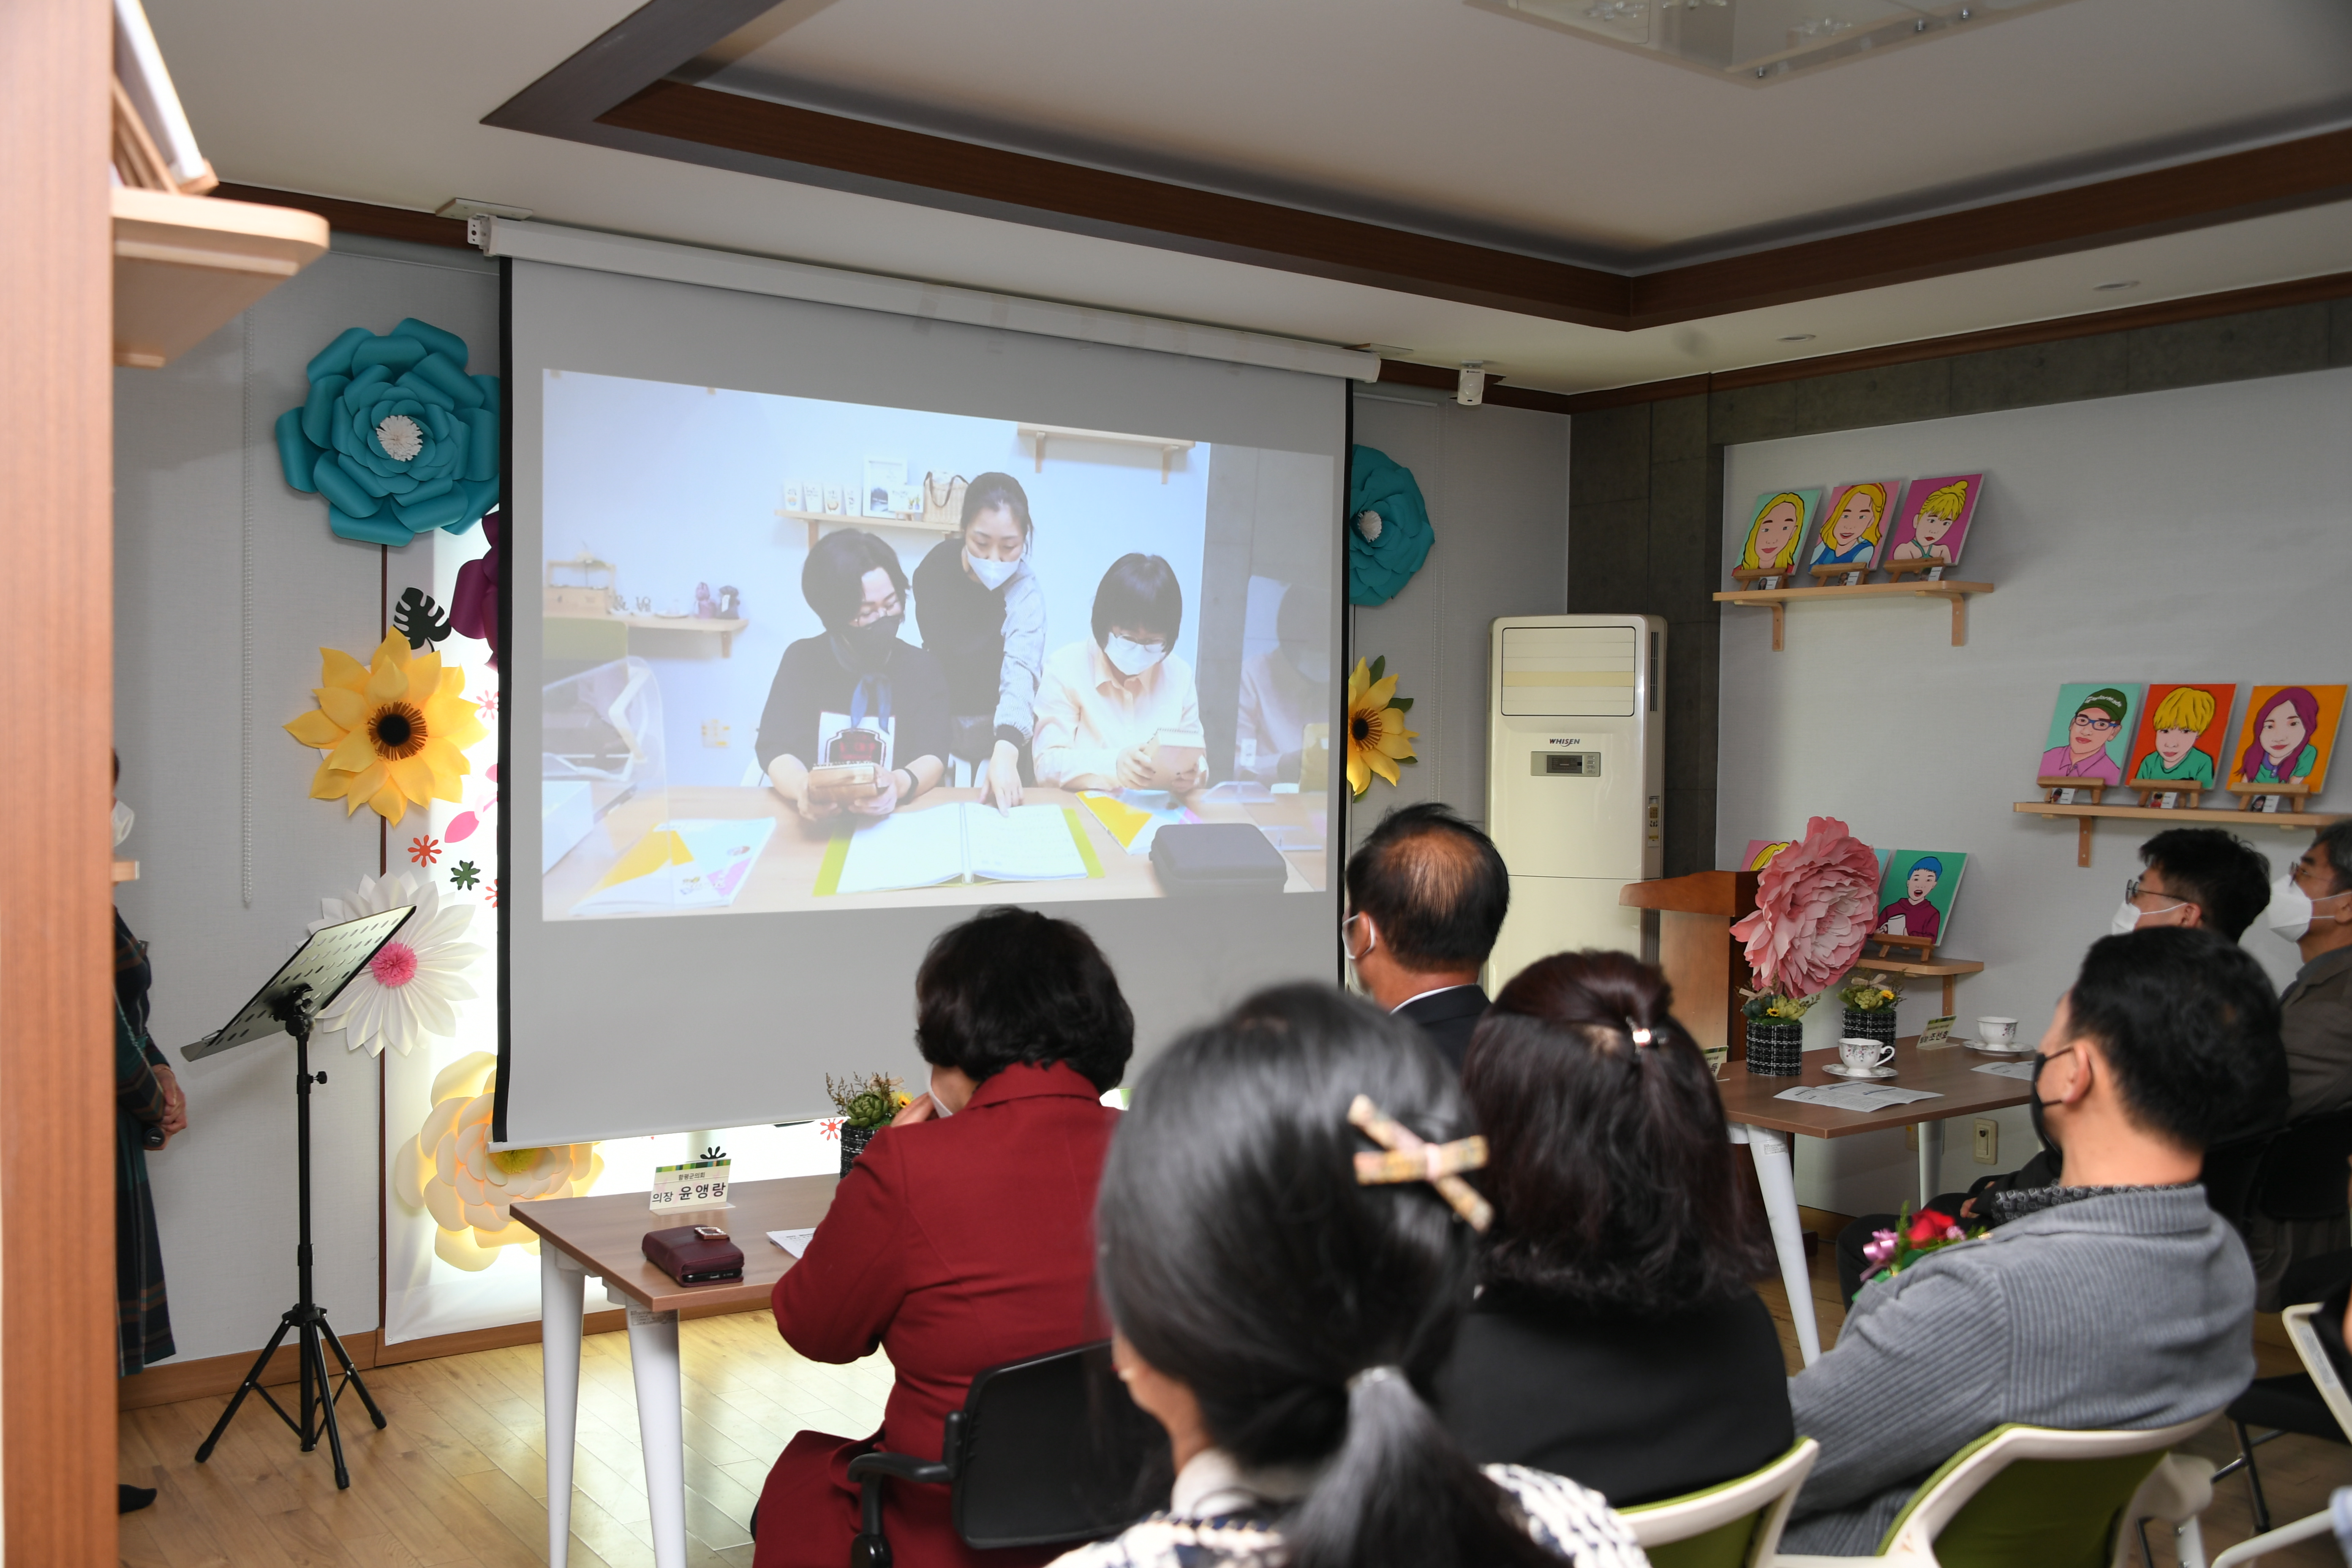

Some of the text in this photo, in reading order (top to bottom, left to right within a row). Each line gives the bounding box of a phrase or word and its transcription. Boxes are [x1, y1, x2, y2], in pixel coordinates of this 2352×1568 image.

[1549, 738, 1580, 747] WHISEN
[678, 1172, 705, 1181] 함평군의회
[652, 1182, 726, 1203] 의장 윤앵랑
